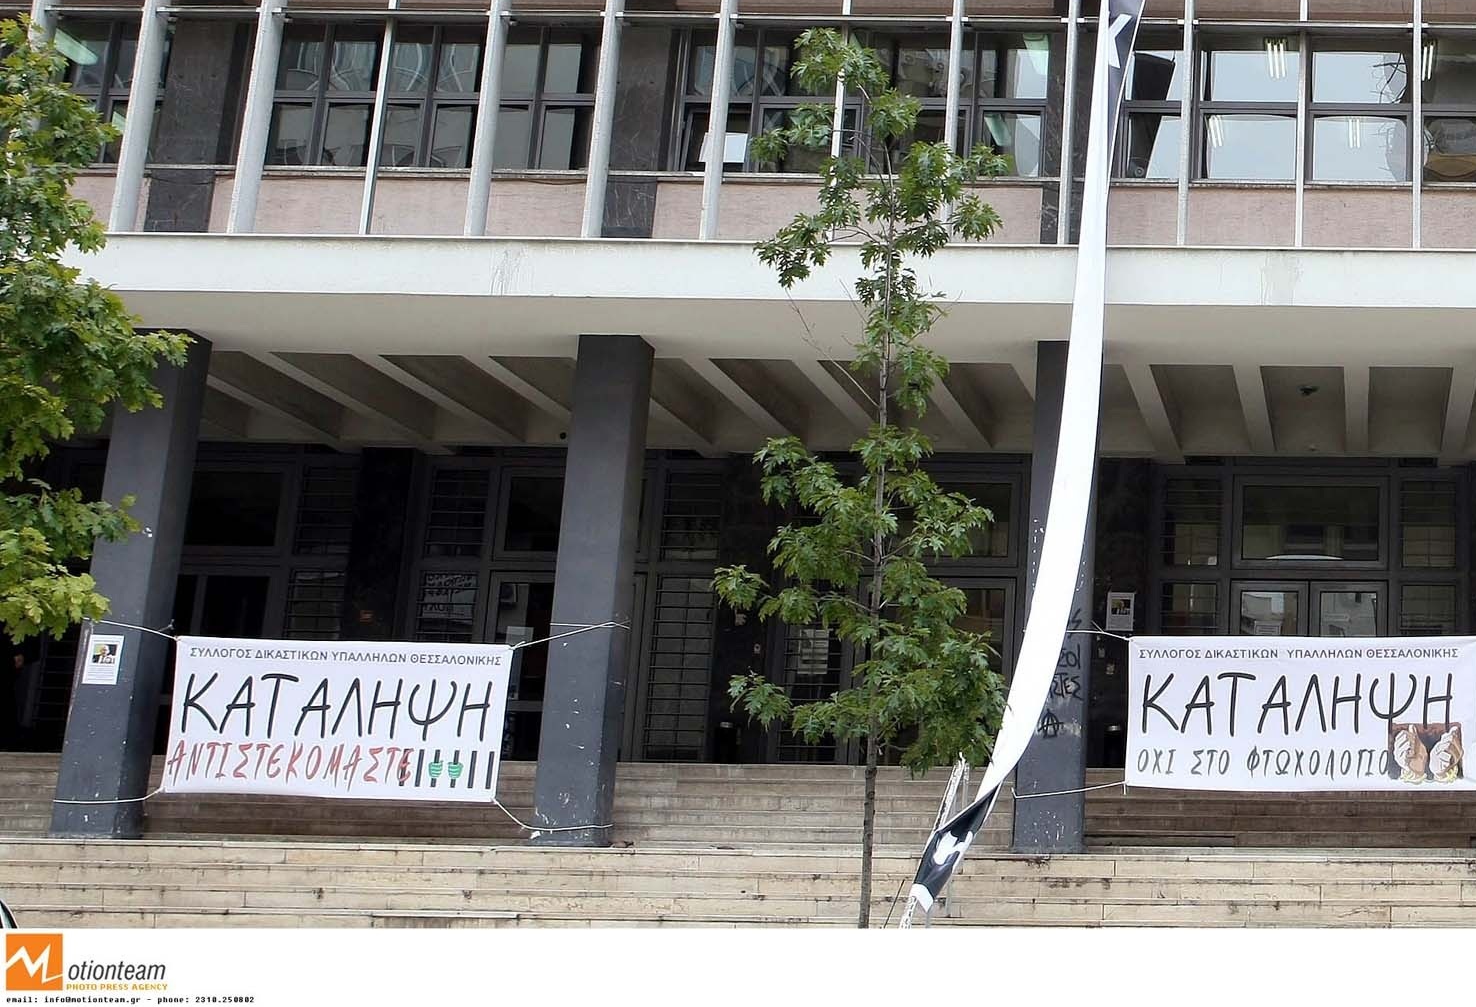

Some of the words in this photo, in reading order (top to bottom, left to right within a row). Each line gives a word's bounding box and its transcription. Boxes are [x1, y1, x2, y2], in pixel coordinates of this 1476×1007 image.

[190, 647, 252, 659] ΣΥΛΛΟΓΟΣ
[255, 649, 328, 661] ΔΙΚΑΣΤΙΚΩΝ
[331, 651, 406, 663] ΥΠΑΛΛΗΛΩΝ
[410, 653, 502, 666] ΘΕΣΣΑΛΟΝΙΚΗΣ
[1139, 648, 1202, 659] ΣΥΛΛΟΓΟΣ
[1205, 648, 1278, 659] ΔΙΚΑΣΤΙΚΩΝ
[1287, 648, 1362, 658] ΥΠΑΛΛΗΛΩΝ
[1366, 648, 1459, 659] ΘΕΣΣΑΛΟΝΙΚΗΣ
[181, 672, 493, 742] ΚΑΤΑΛΗΨΗ
[1141, 671, 1453, 737] ΚΑΤΑΛΗΨΗ
[167, 739, 415, 791] ΑΝΤΙΣΤΕΚΟΜΑΣΤΕ
[1137, 748, 1176, 776] ΟΧΙ
[1191, 748, 1230, 776] ΣΤΟ
